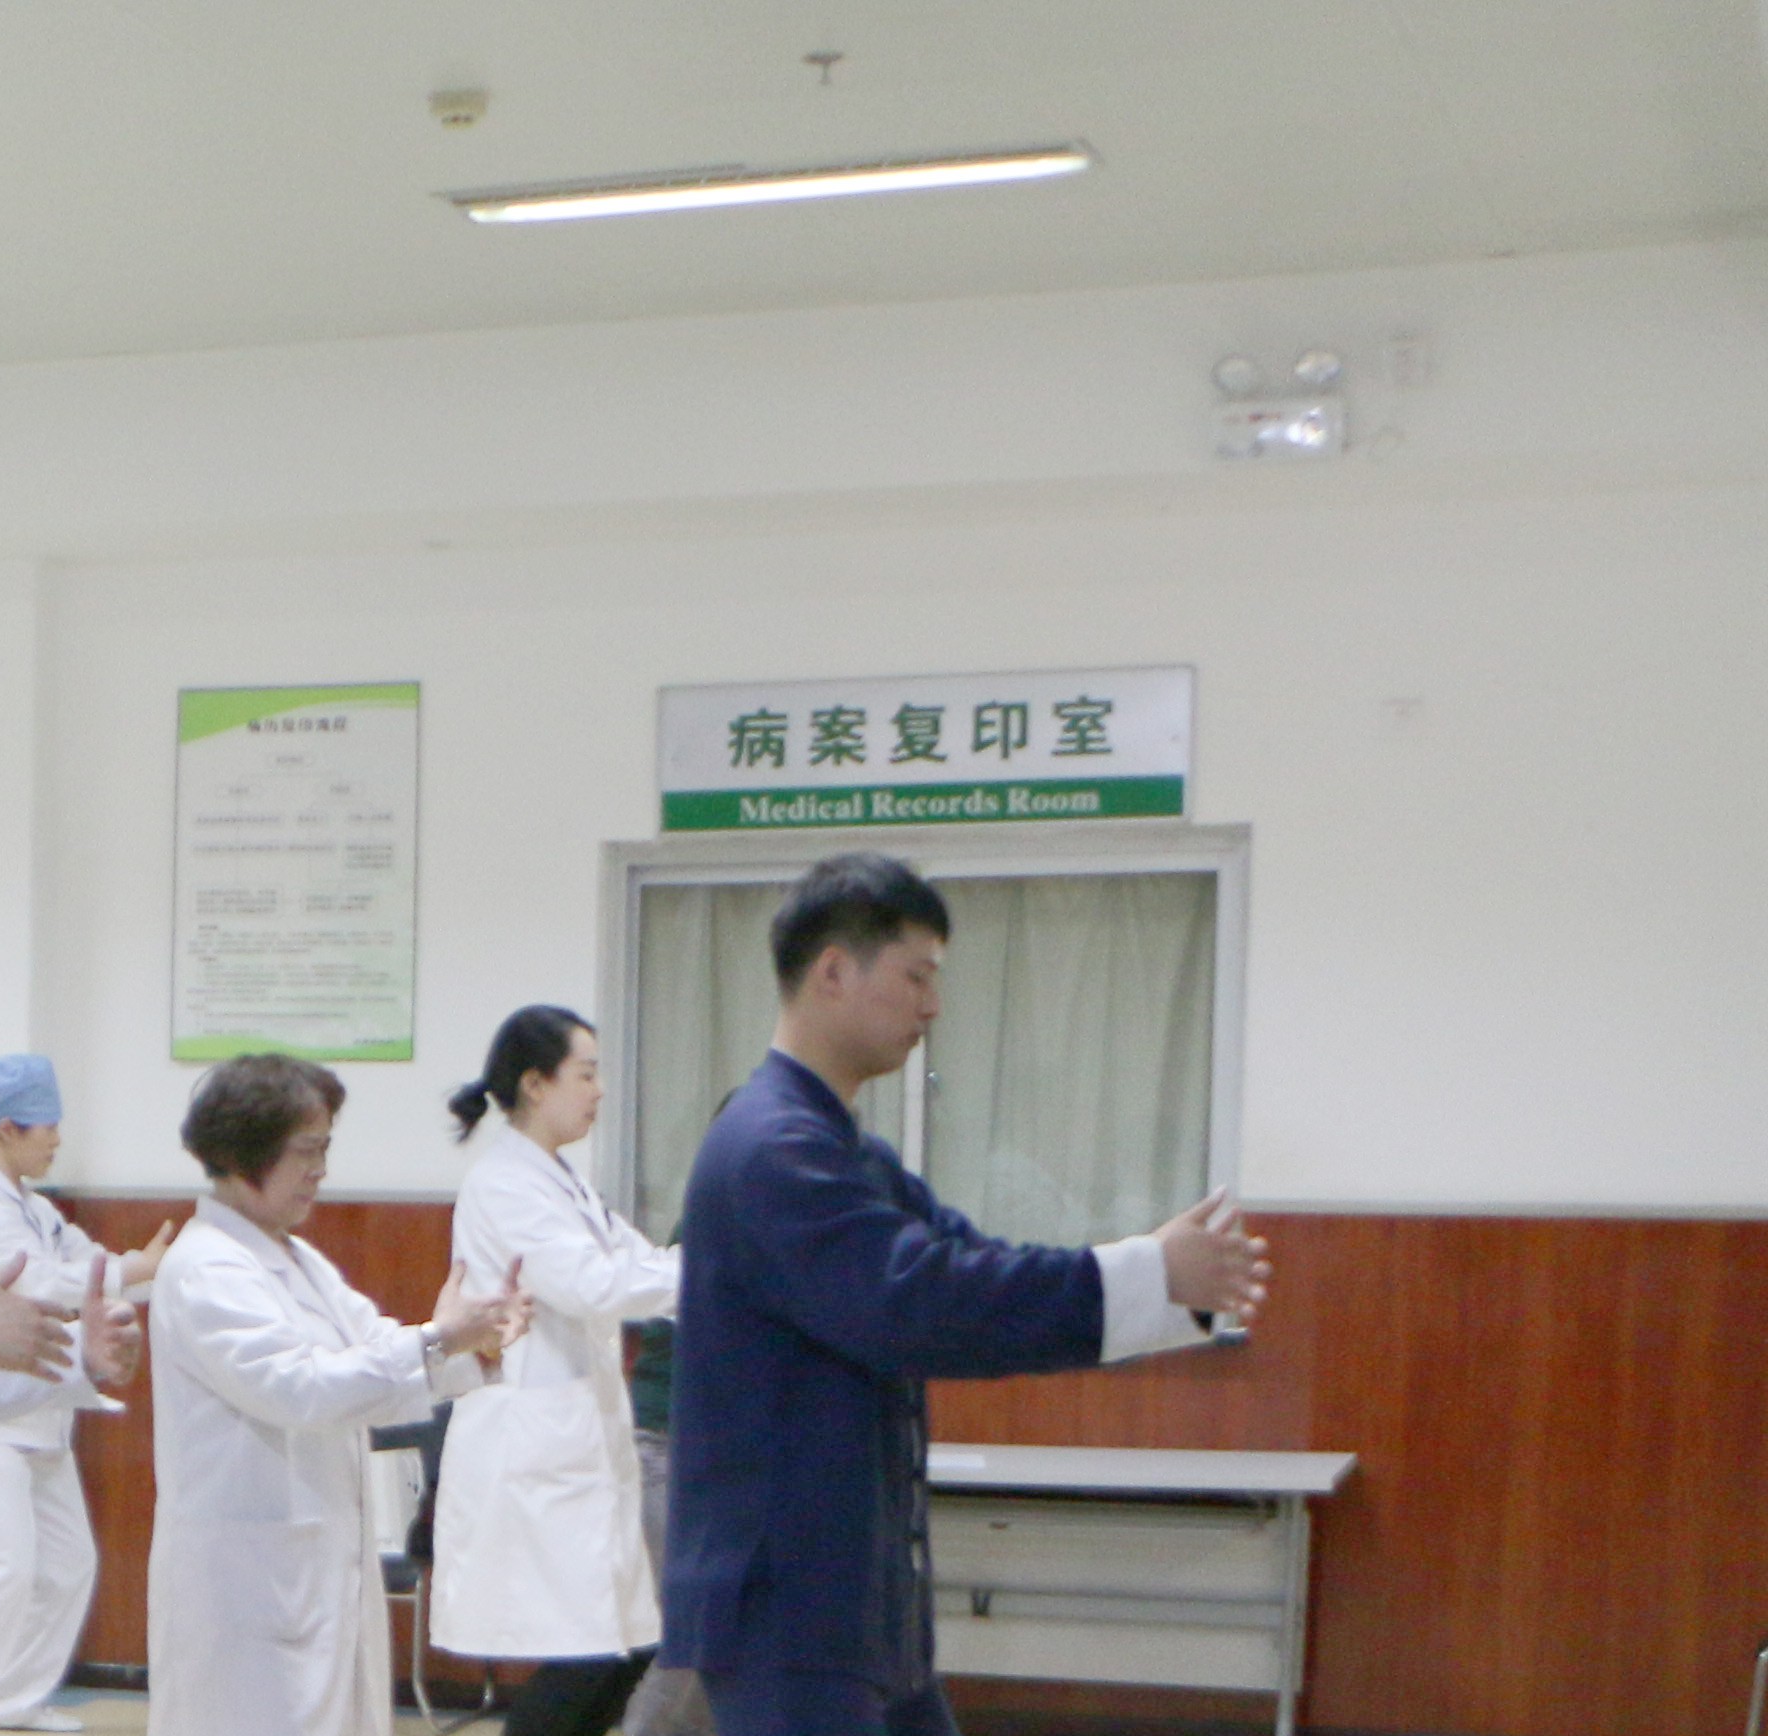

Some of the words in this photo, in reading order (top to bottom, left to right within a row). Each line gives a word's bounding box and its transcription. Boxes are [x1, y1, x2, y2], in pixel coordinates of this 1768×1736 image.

[727, 695, 1114, 768] 病案复印室
[739, 793, 863, 824] Medical
[870, 789, 1000, 819] Records
[1007, 786, 1101, 815] Room
